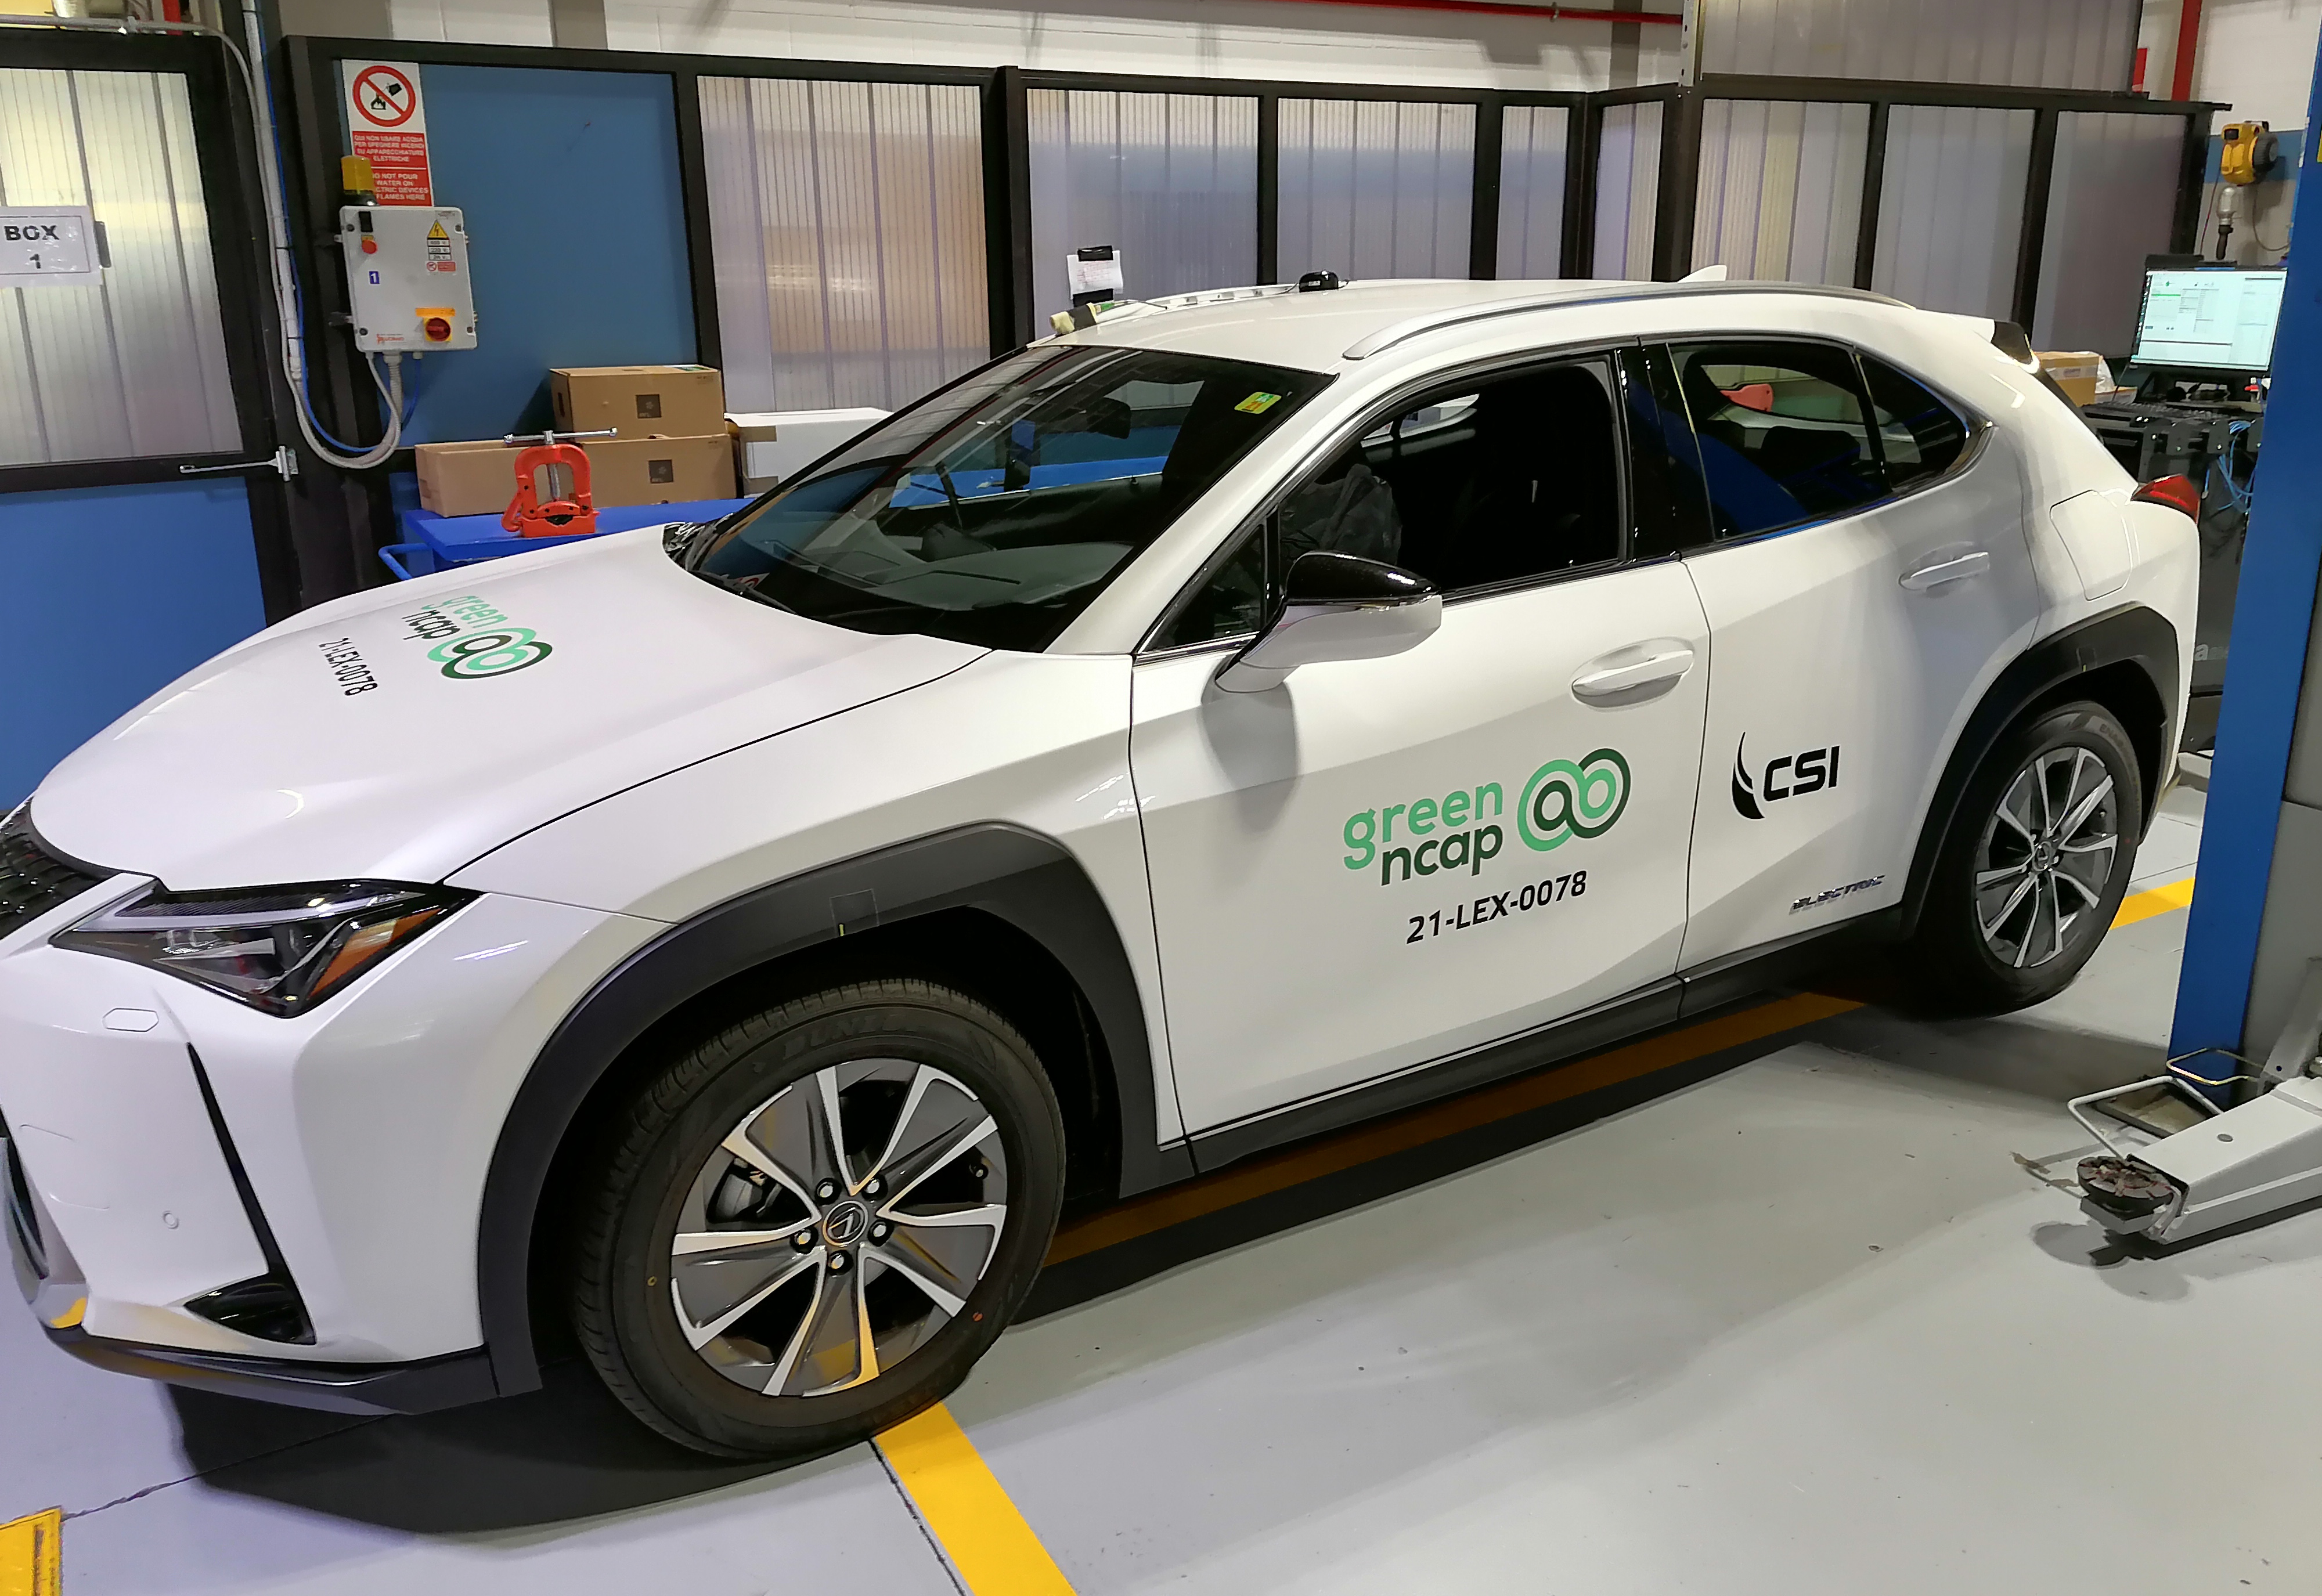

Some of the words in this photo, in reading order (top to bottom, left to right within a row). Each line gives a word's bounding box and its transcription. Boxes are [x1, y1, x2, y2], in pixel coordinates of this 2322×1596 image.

[4, 225, 60, 241] BOX
[30, 254, 41, 269] 1
[370, 273, 377, 283] 1
[401, 609, 461, 641] ncap
[420, 595, 509, 629] green
[318, 637, 378, 696] 21-LEX-0078
[1763, 745, 1840, 802] CSI
[1343, 782, 1503, 870] green
[1381, 825, 1503, 886] ncap
[1407, 870, 1587, 945] 21-LEX-0078
[1793, 875, 1886, 910] ELECTRIC
